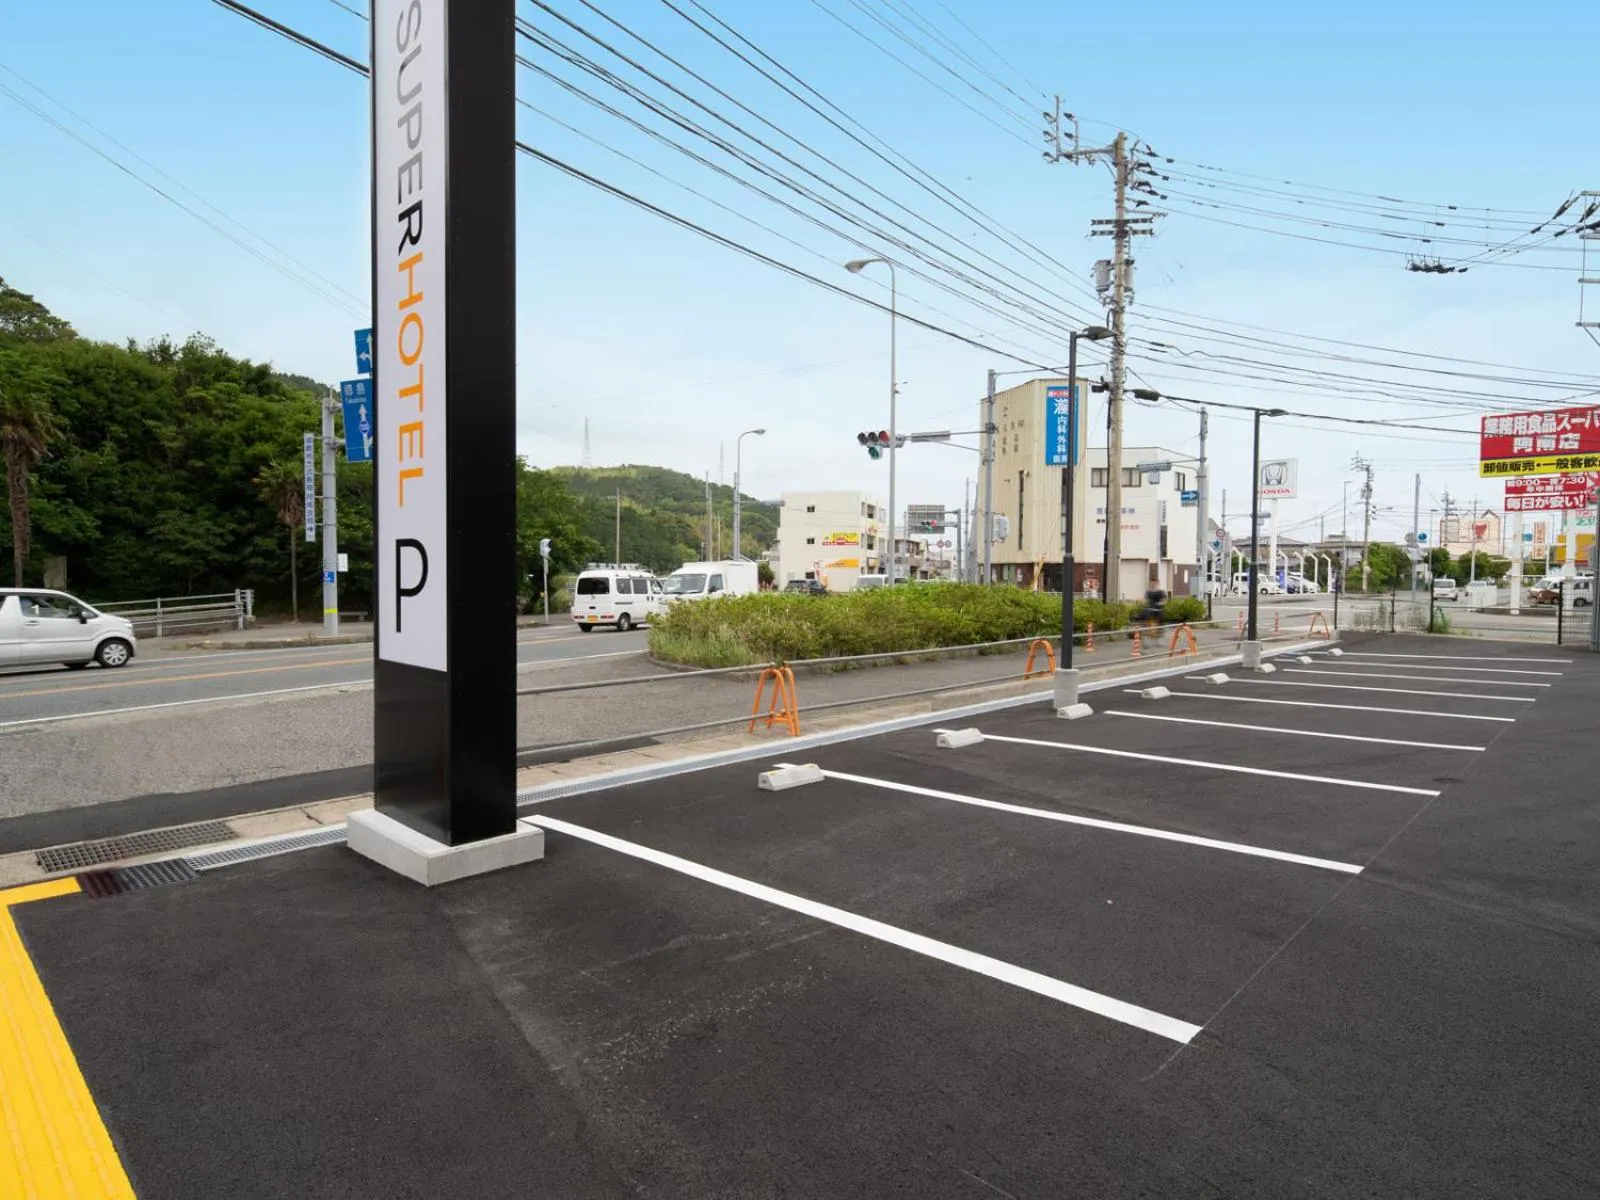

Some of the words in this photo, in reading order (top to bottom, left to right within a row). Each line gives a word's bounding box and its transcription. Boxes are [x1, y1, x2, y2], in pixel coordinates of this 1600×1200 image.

[1513, 433, 1581, 454] 阿南店
[1483, 455, 1600, 474] 卸値販売・一般客歓
[395, 538, 429, 633] P
